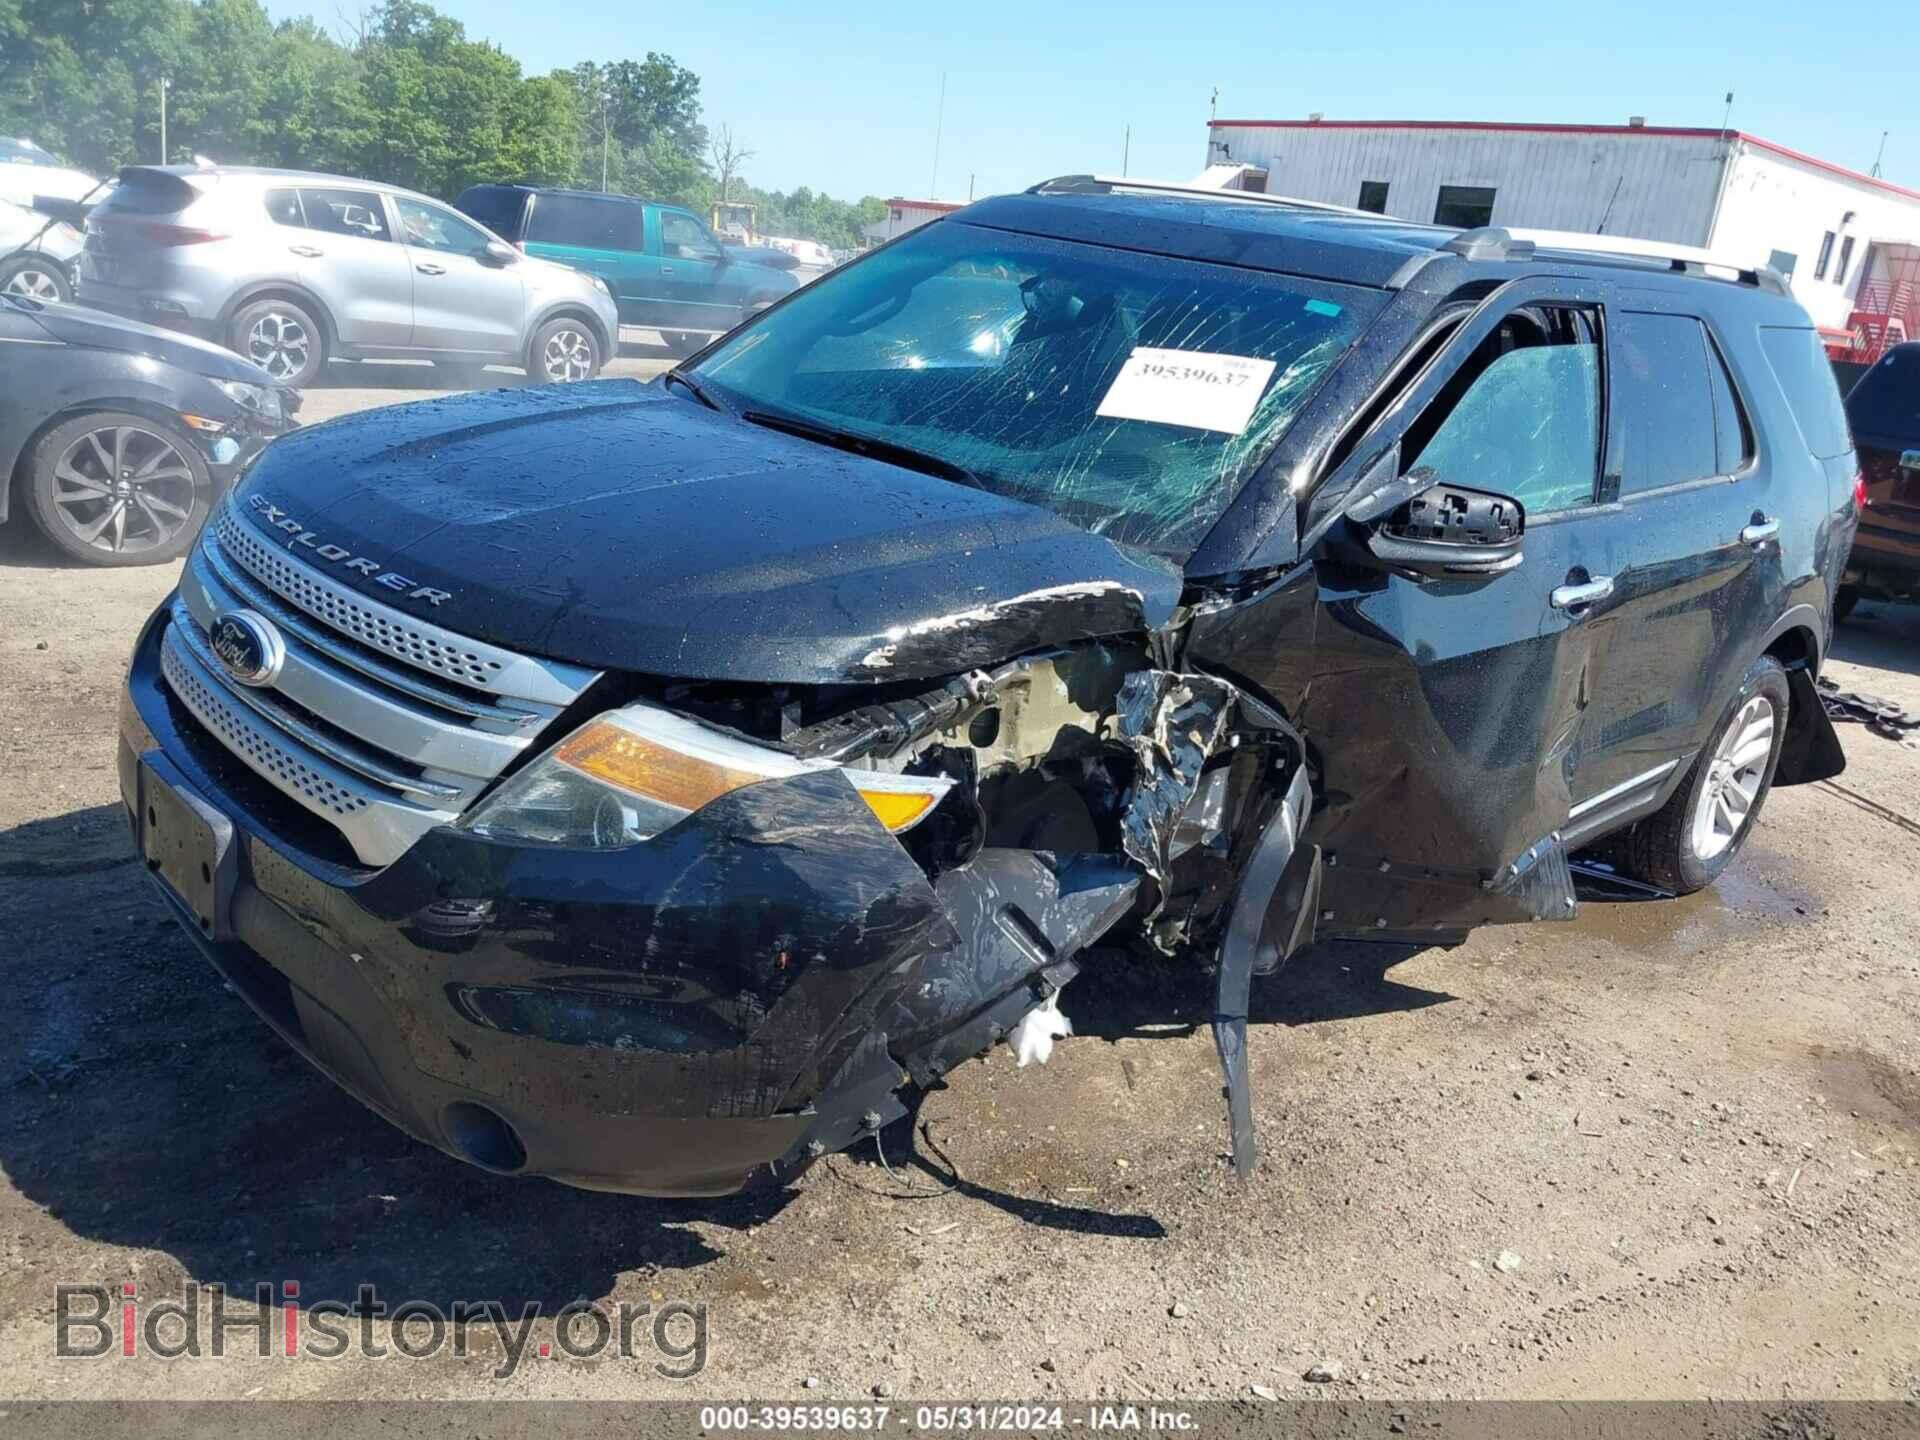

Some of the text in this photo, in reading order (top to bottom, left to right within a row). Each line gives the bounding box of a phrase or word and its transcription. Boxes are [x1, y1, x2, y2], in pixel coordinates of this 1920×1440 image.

[1134, 362, 1251, 387] 39539637
[249, 493, 453, 606] EXPLORER
[214, 622, 252, 669] Ford
